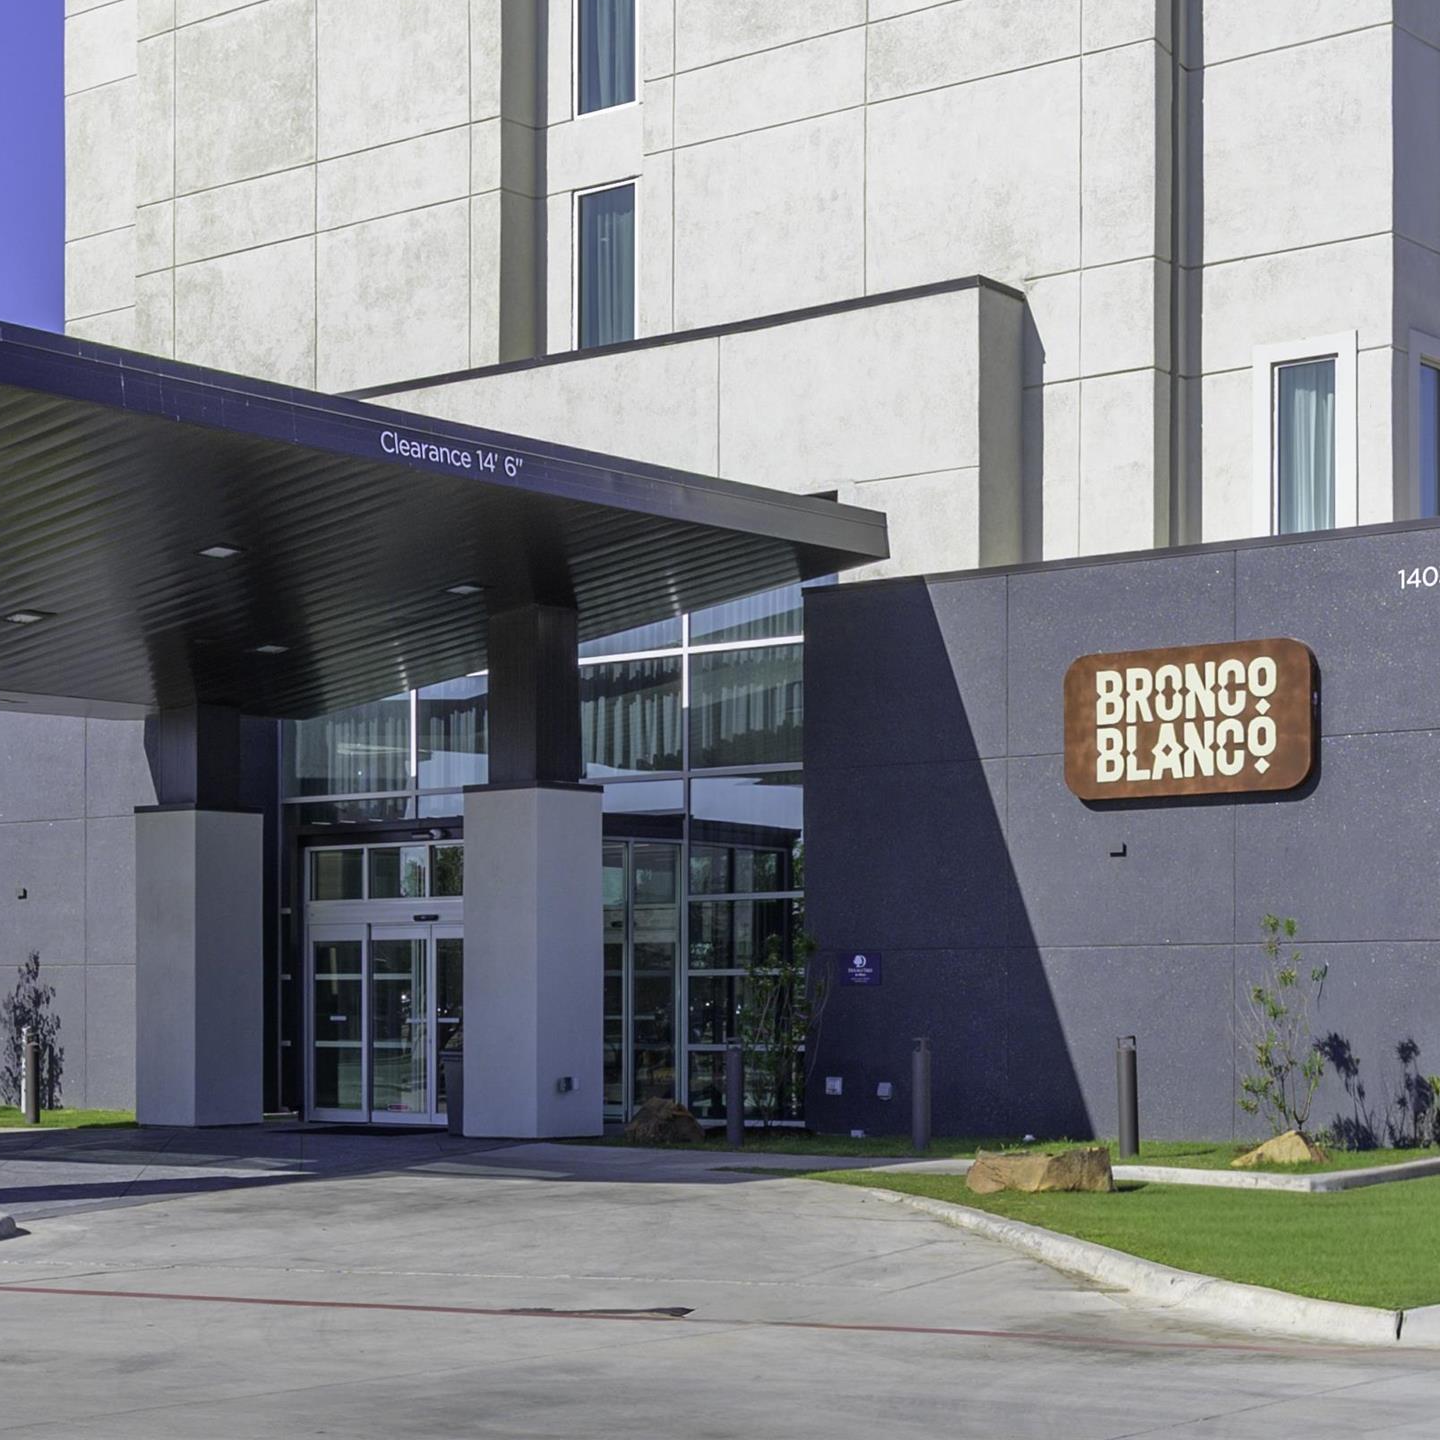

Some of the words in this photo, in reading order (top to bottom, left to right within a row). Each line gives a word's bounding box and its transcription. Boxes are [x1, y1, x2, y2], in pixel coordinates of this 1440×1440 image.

[380, 431, 472, 468] Clearance
[476, 450, 498, 472] 14'
[504, 455, 523, 477] 6"
[1096, 656, 1277, 725] BRONCO
[1096, 716, 1277, 783] BLANCO
